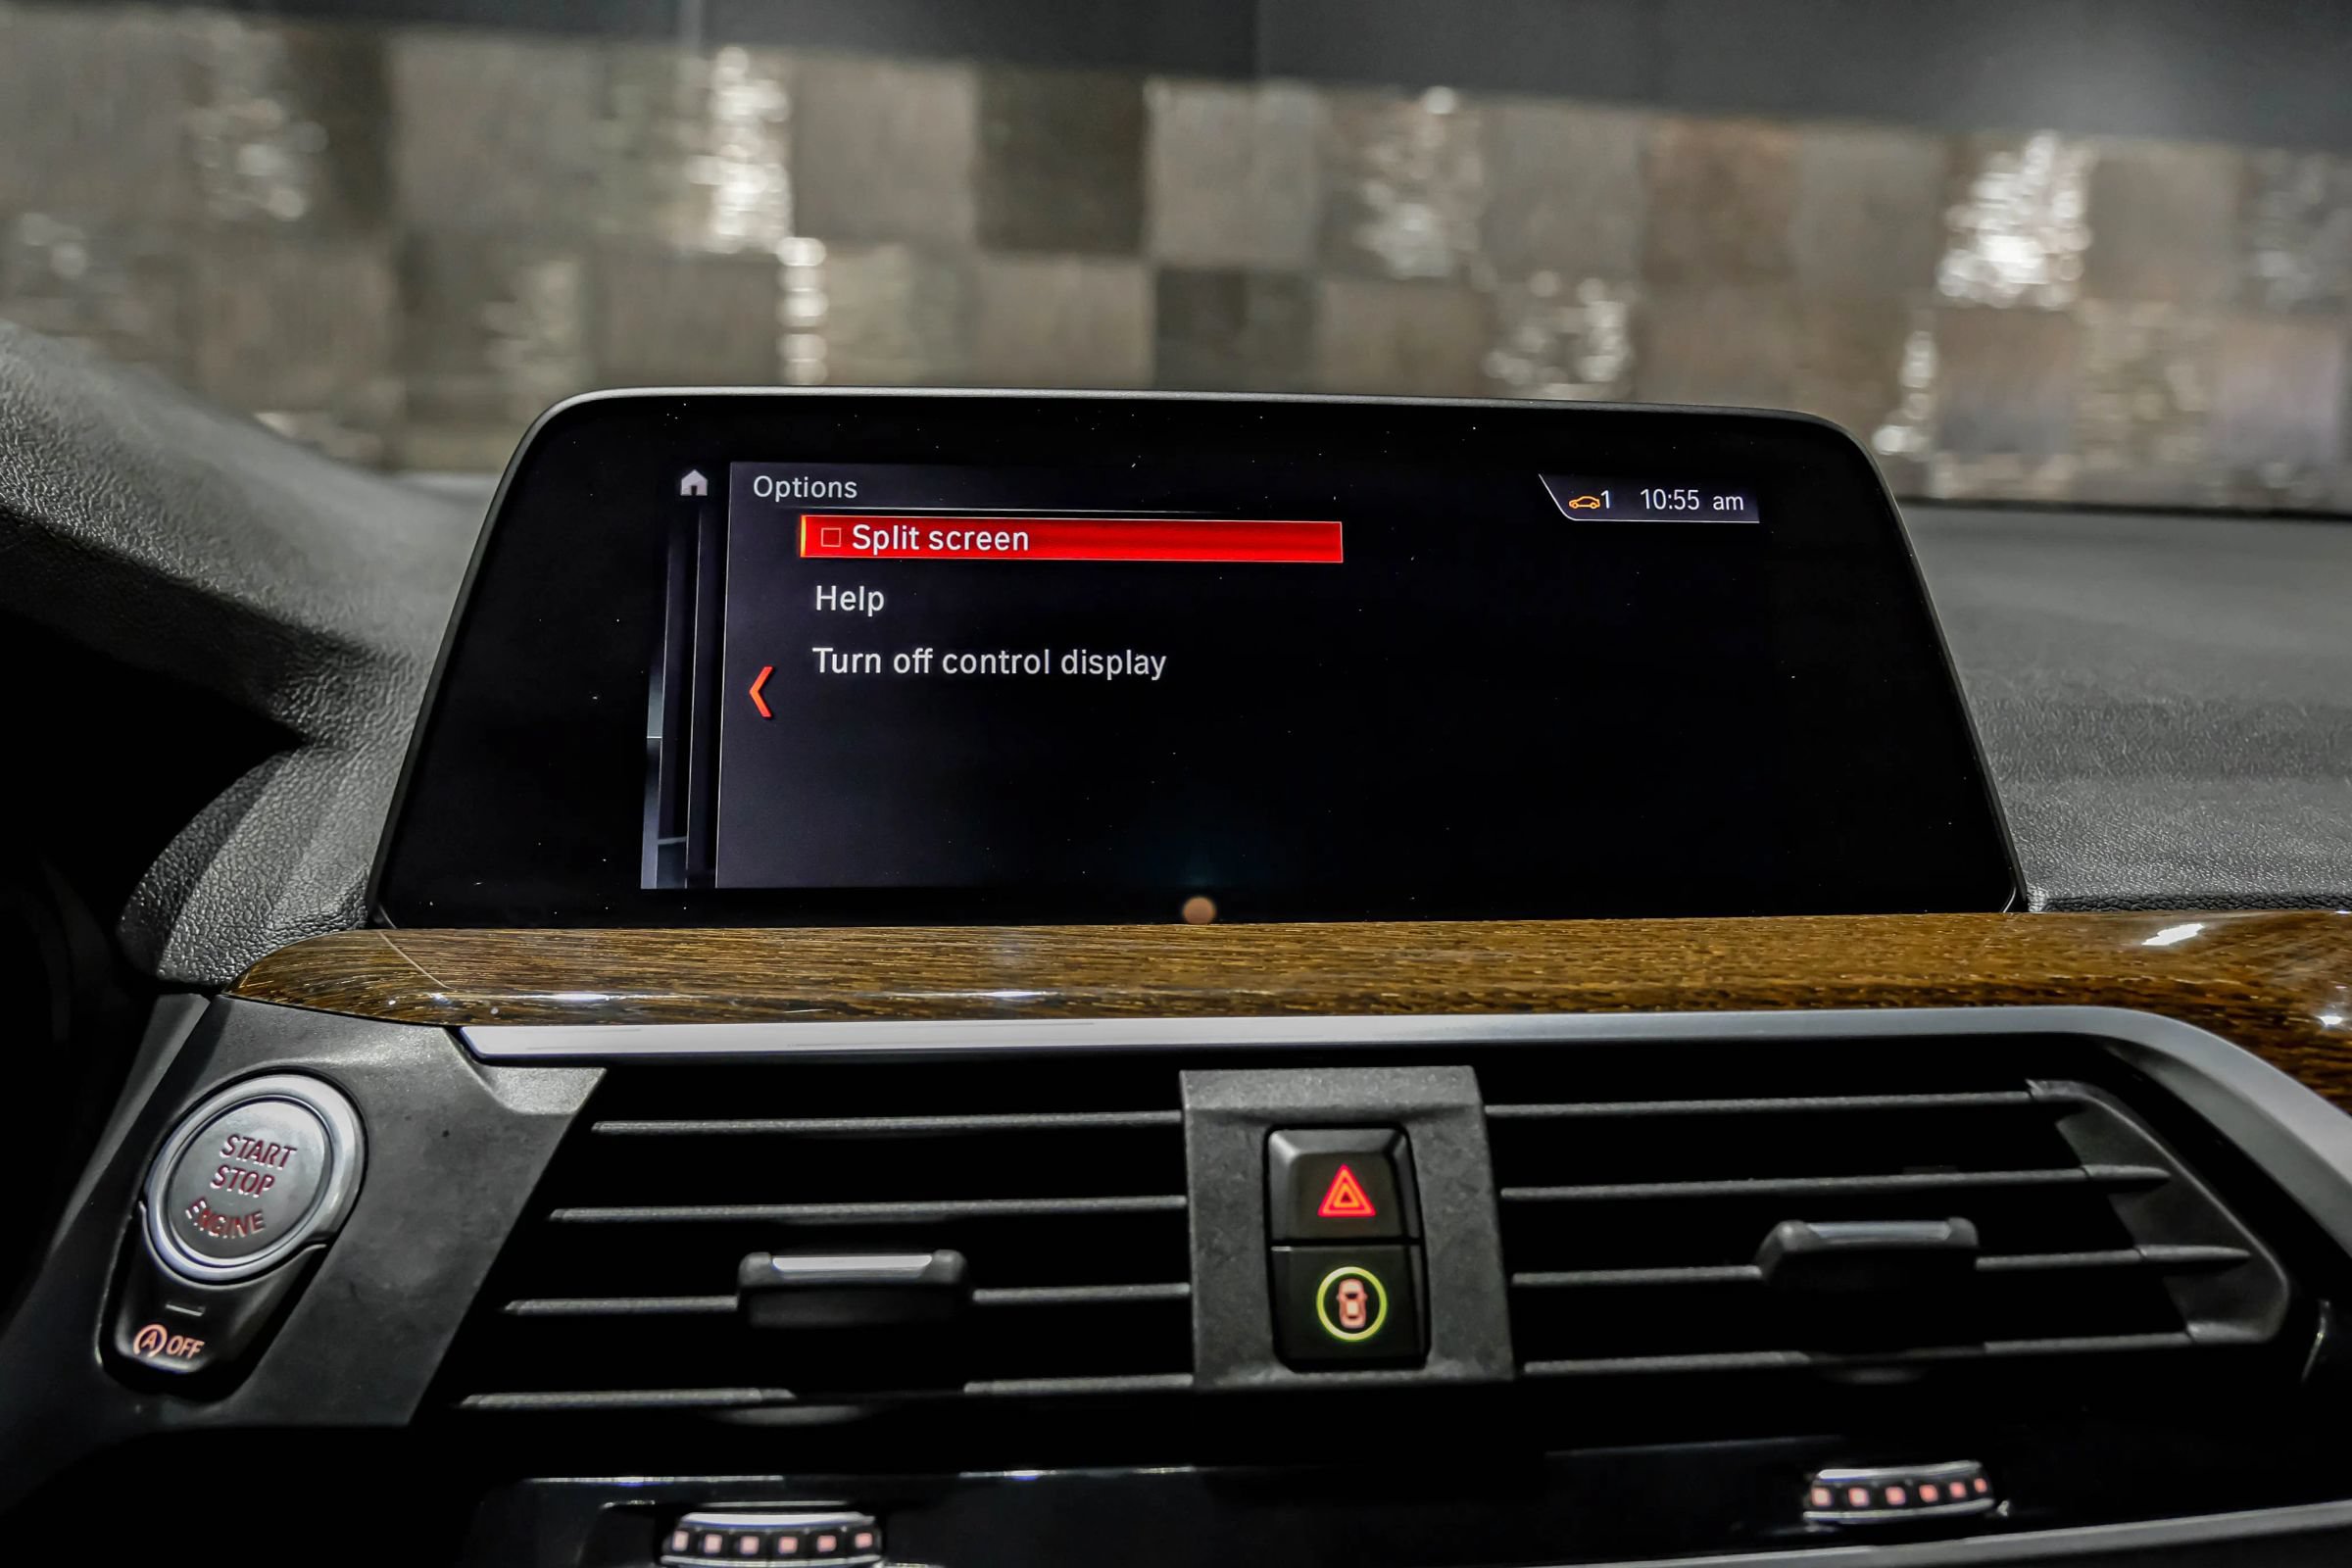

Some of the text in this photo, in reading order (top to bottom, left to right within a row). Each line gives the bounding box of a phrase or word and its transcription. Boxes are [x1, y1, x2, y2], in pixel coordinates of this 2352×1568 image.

[753, 474, 858, 503] Options
[1641, 489, 1743, 511] 10:55 am
[851, 523, 1030, 556] Split screen
[814, 585, 885, 617] Help
[812, 647, 1168, 681] Turn off control display
[220, 1134, 297, 1170] START
[210, 1164, 274, 1198] STOP
[166, 1335, 205, 1359] OFF
